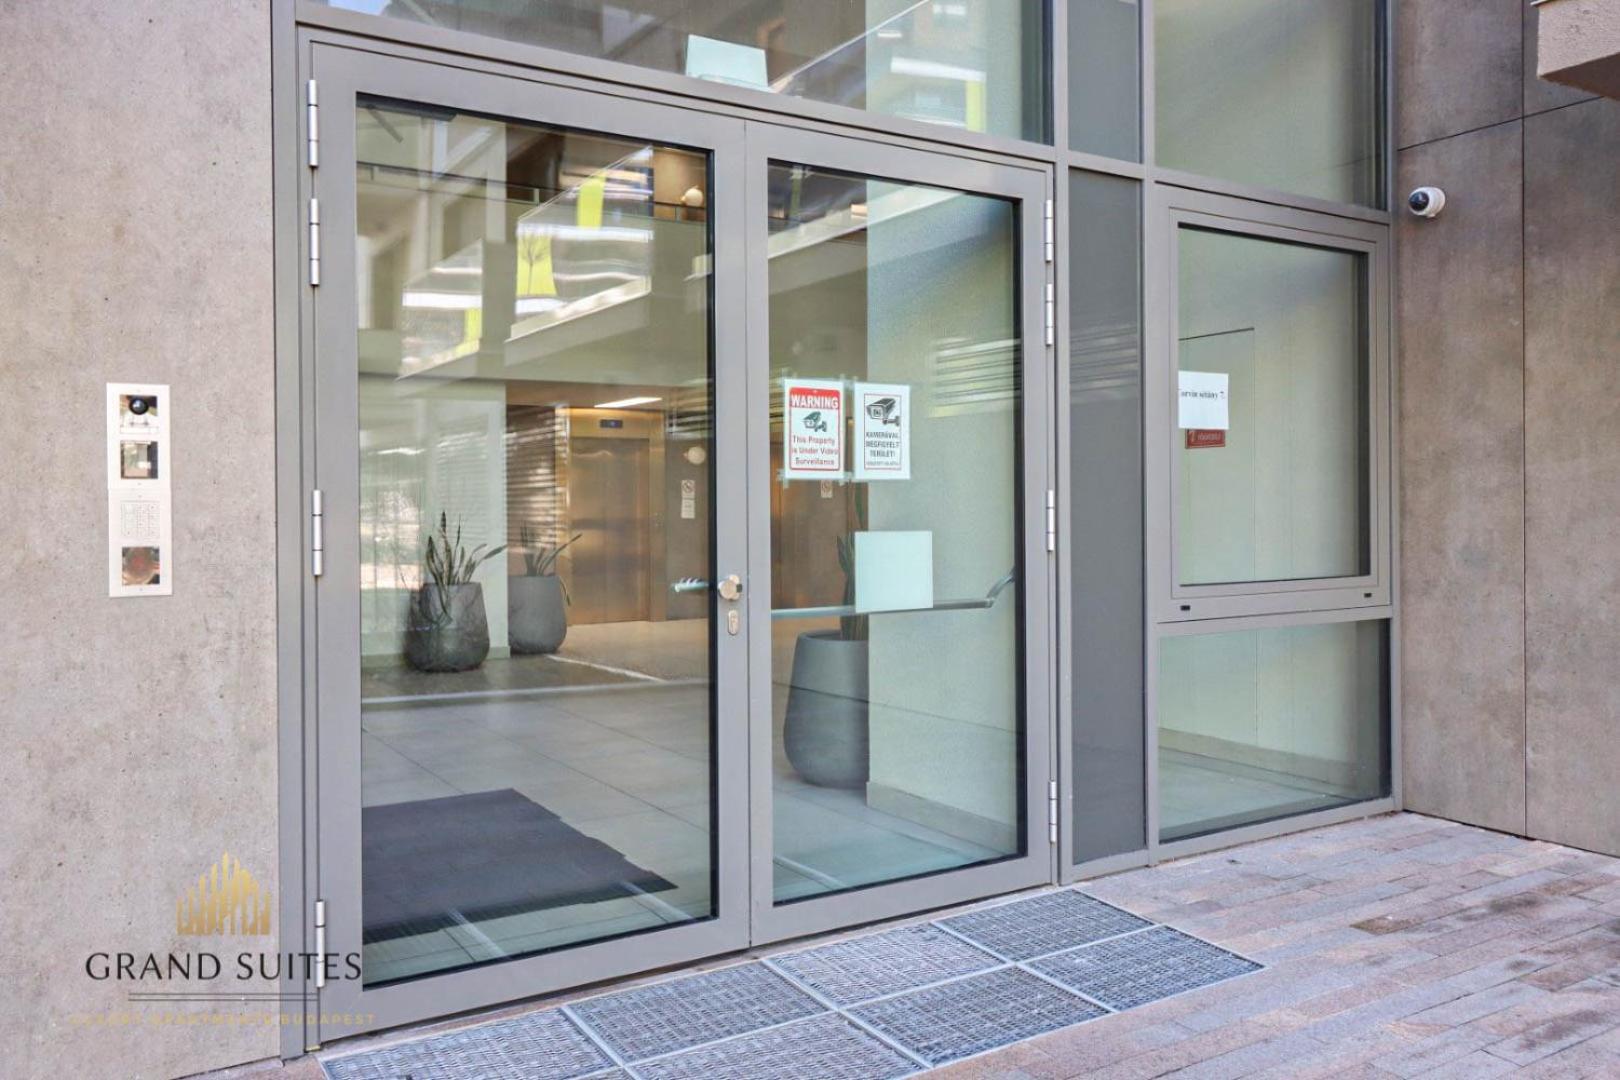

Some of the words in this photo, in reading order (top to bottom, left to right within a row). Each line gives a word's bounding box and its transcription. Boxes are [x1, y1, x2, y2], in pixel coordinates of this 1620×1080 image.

[790, 394, 839, 410] WARNING
[793, 435, 807, 443] This
[809, 435, 835, 446] Property
[799, 447, 818, 455] Under
[795, 457, 835, 465] Surveillance
